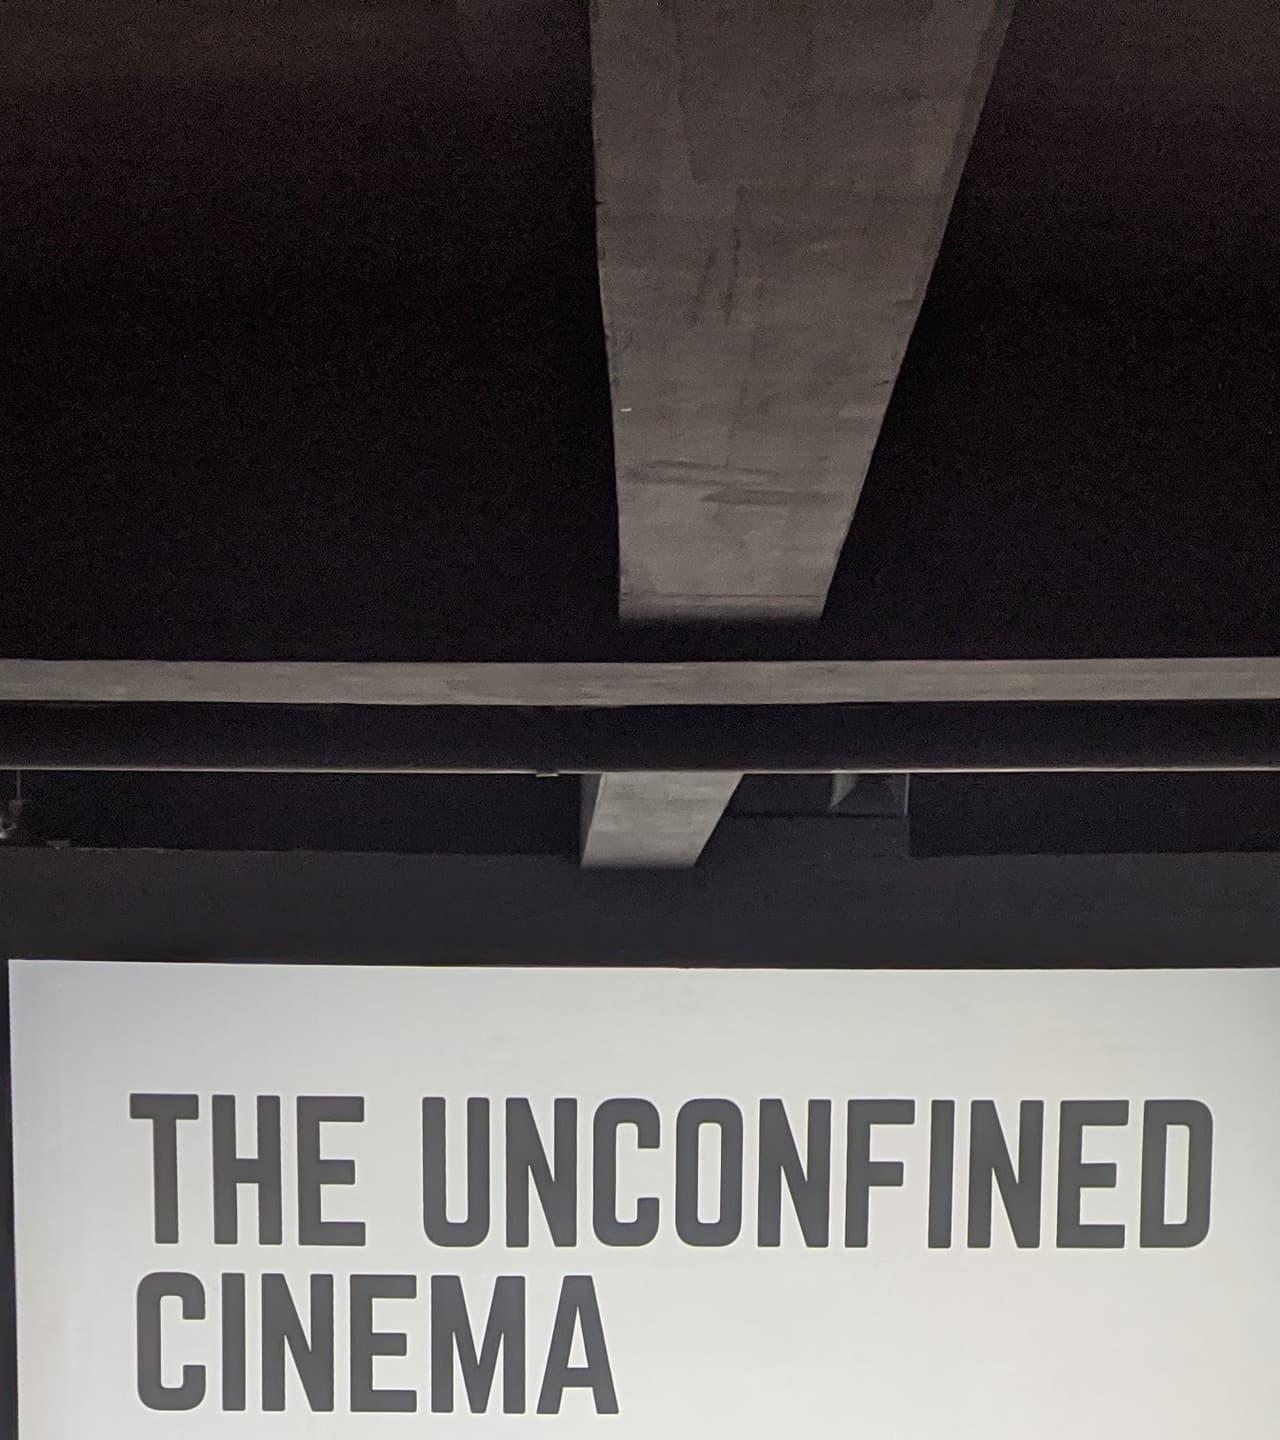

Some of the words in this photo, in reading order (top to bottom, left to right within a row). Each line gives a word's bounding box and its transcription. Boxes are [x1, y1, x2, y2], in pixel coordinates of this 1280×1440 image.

[129, 1092, 366, 1247] THE
[422, 1096, 1214, 1249] UNCONFINED
[136, 1271, 620, 1415] CINEMA
